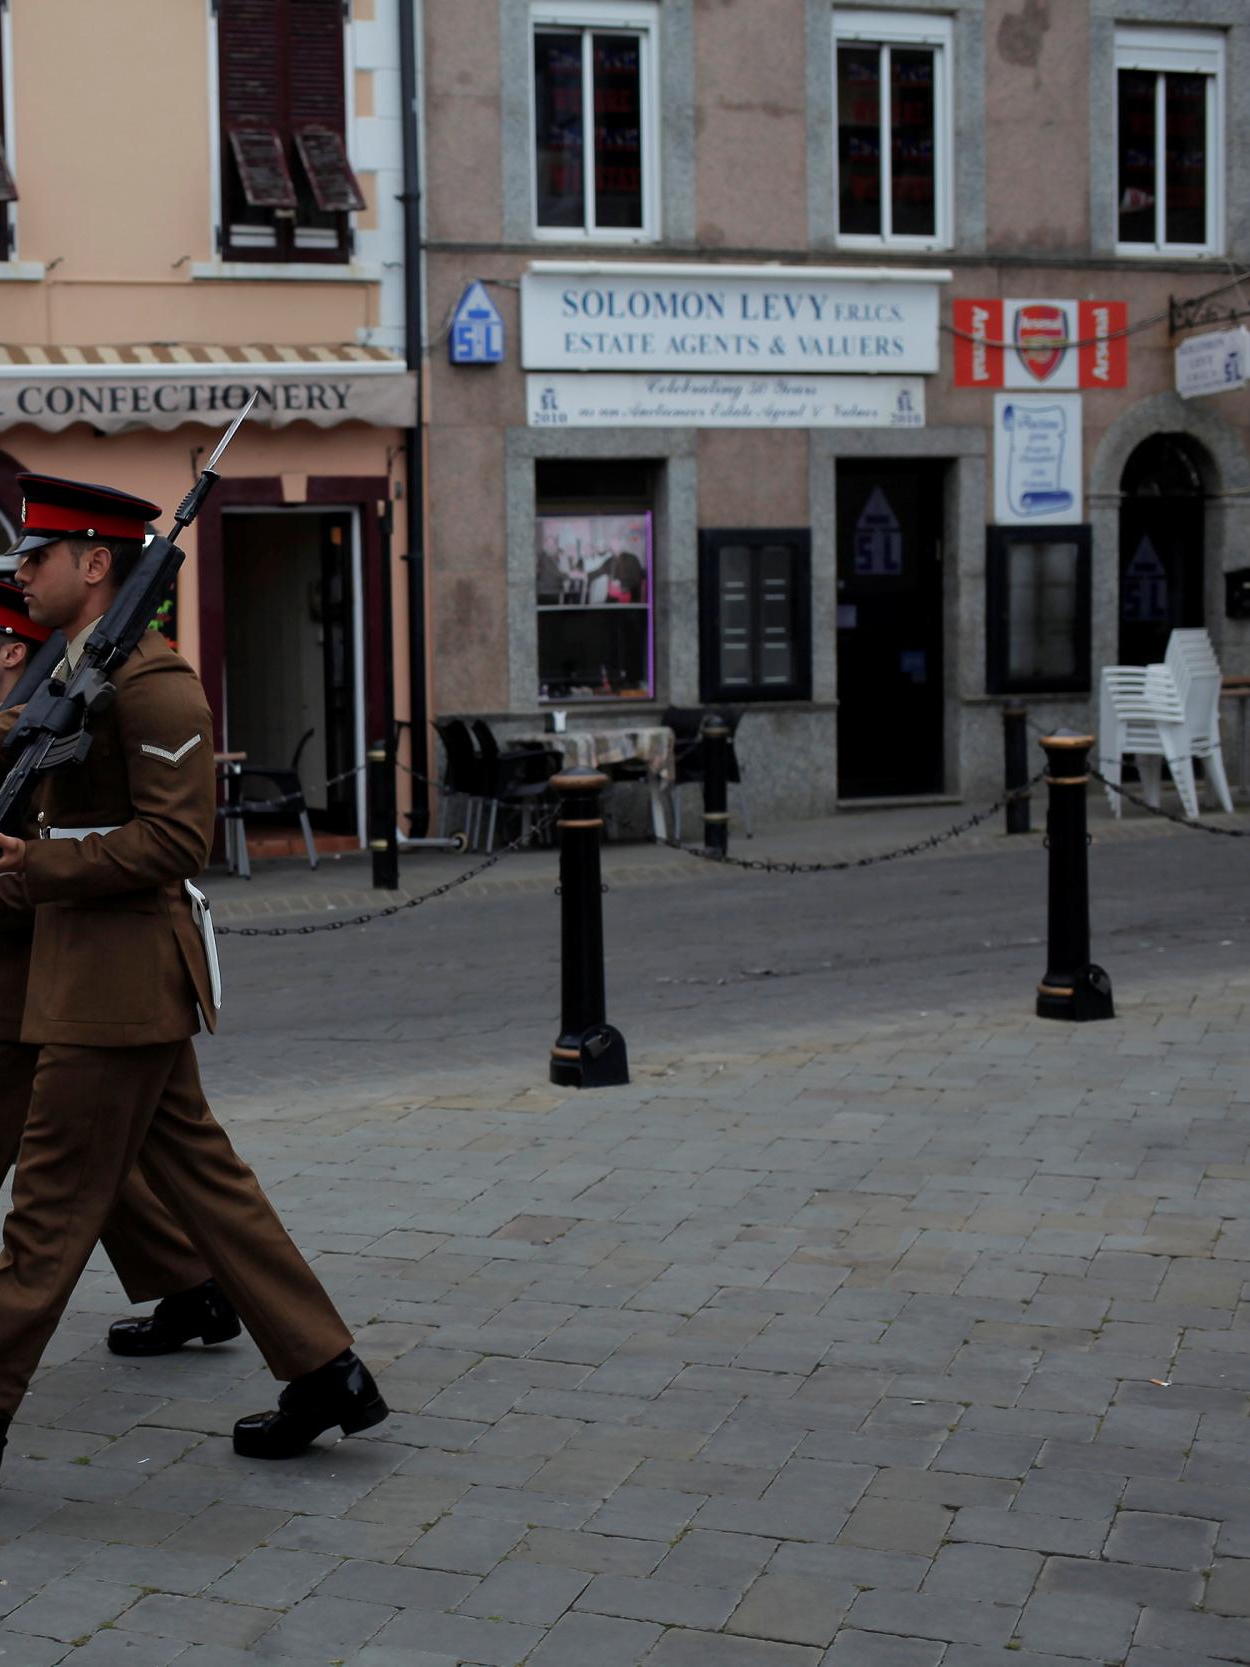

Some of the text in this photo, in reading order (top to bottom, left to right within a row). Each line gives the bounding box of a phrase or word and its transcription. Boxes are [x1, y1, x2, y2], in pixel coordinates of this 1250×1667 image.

[562, 288, 725, 321] SOLOMON
[740, 292, 829, 321] LEVY
[564, 332, 905, 357] ESTATE AGENTS & VALUERS
[16, 382, 352, 417] CONFECTIONERY
